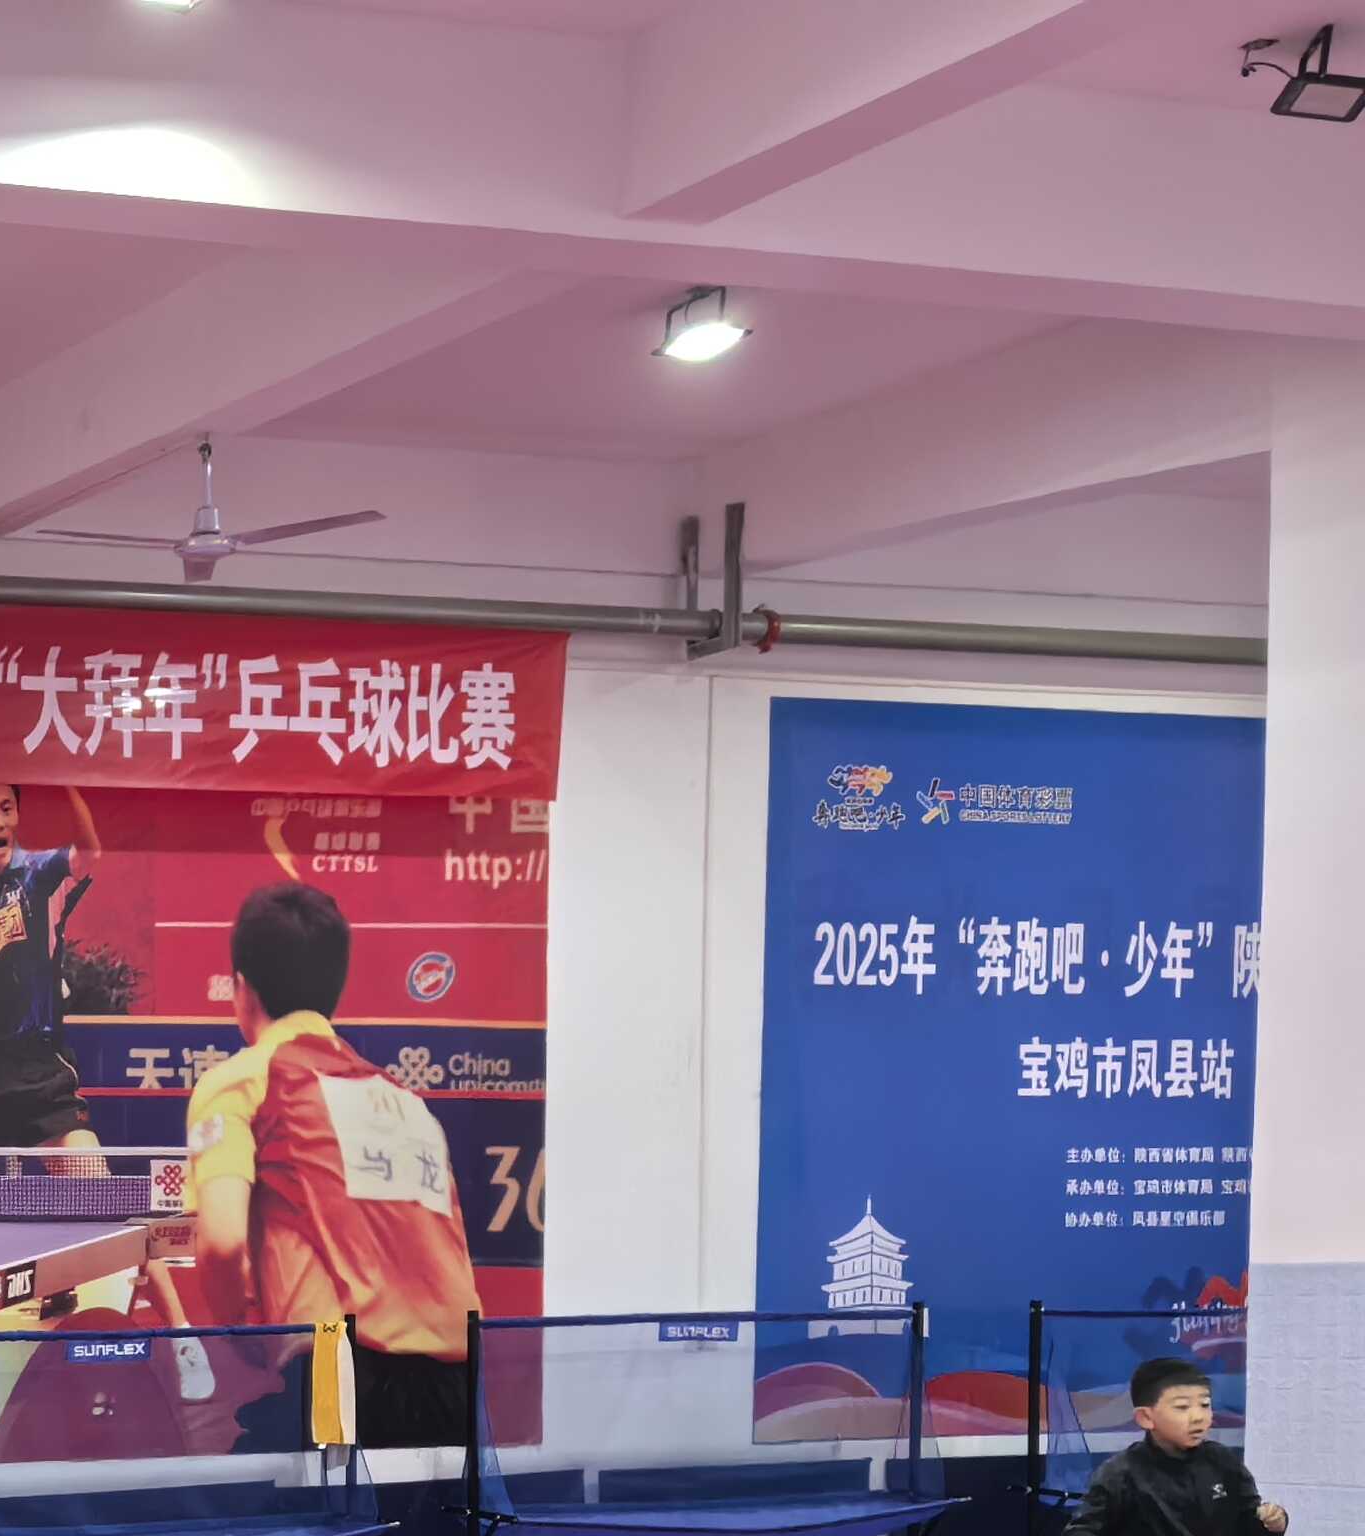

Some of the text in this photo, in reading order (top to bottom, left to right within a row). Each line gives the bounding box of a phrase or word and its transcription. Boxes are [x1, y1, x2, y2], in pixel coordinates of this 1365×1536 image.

[312, 855, 379, 873] CTTSL
[449, 1052, 510, 1077] China
[1016, 1036, 1235, 1100] 宝鸡市凤县站
[73, 1341, 145, 1358] SUNFLEX
